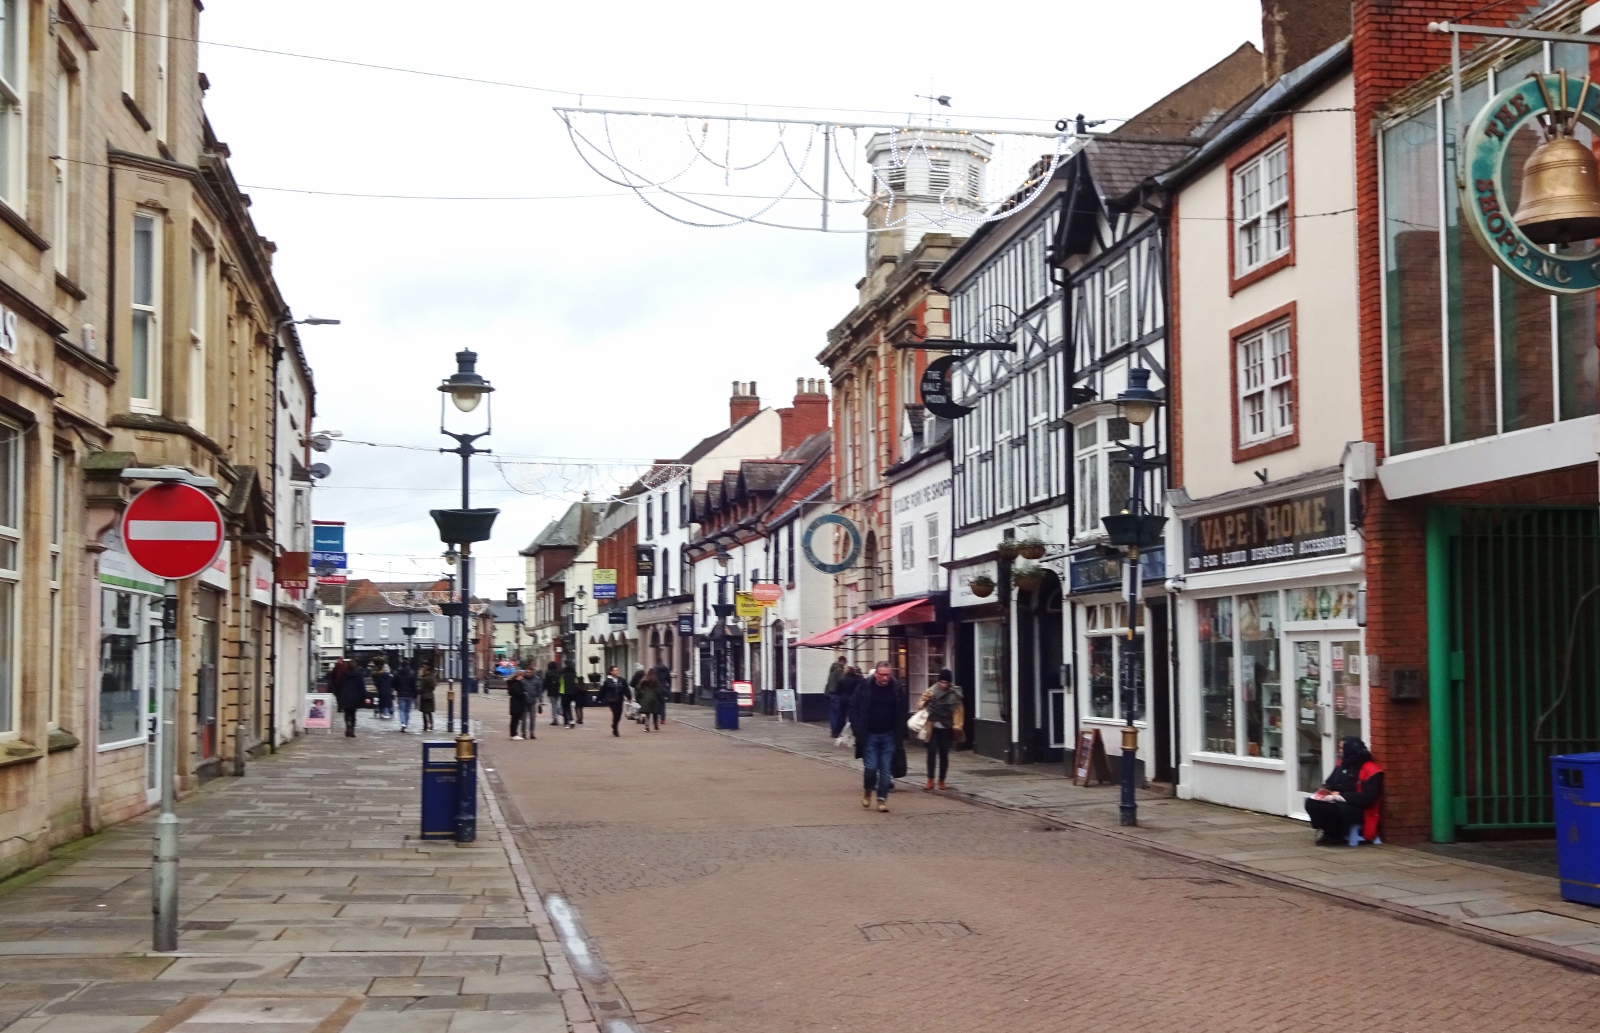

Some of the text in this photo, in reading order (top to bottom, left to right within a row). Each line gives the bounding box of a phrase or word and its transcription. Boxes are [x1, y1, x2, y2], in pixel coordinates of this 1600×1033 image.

[1485, 93, 1530, 141] THE
[1476, 178, 1573, 285] SHOPPING
[922, 382, 942, 392] HALF
[926, 370, 941, 380] THE
[1200, 496, 1327, 551] VAPE HOME
[1298, 535, 1347, 554] ACCESSORIES
